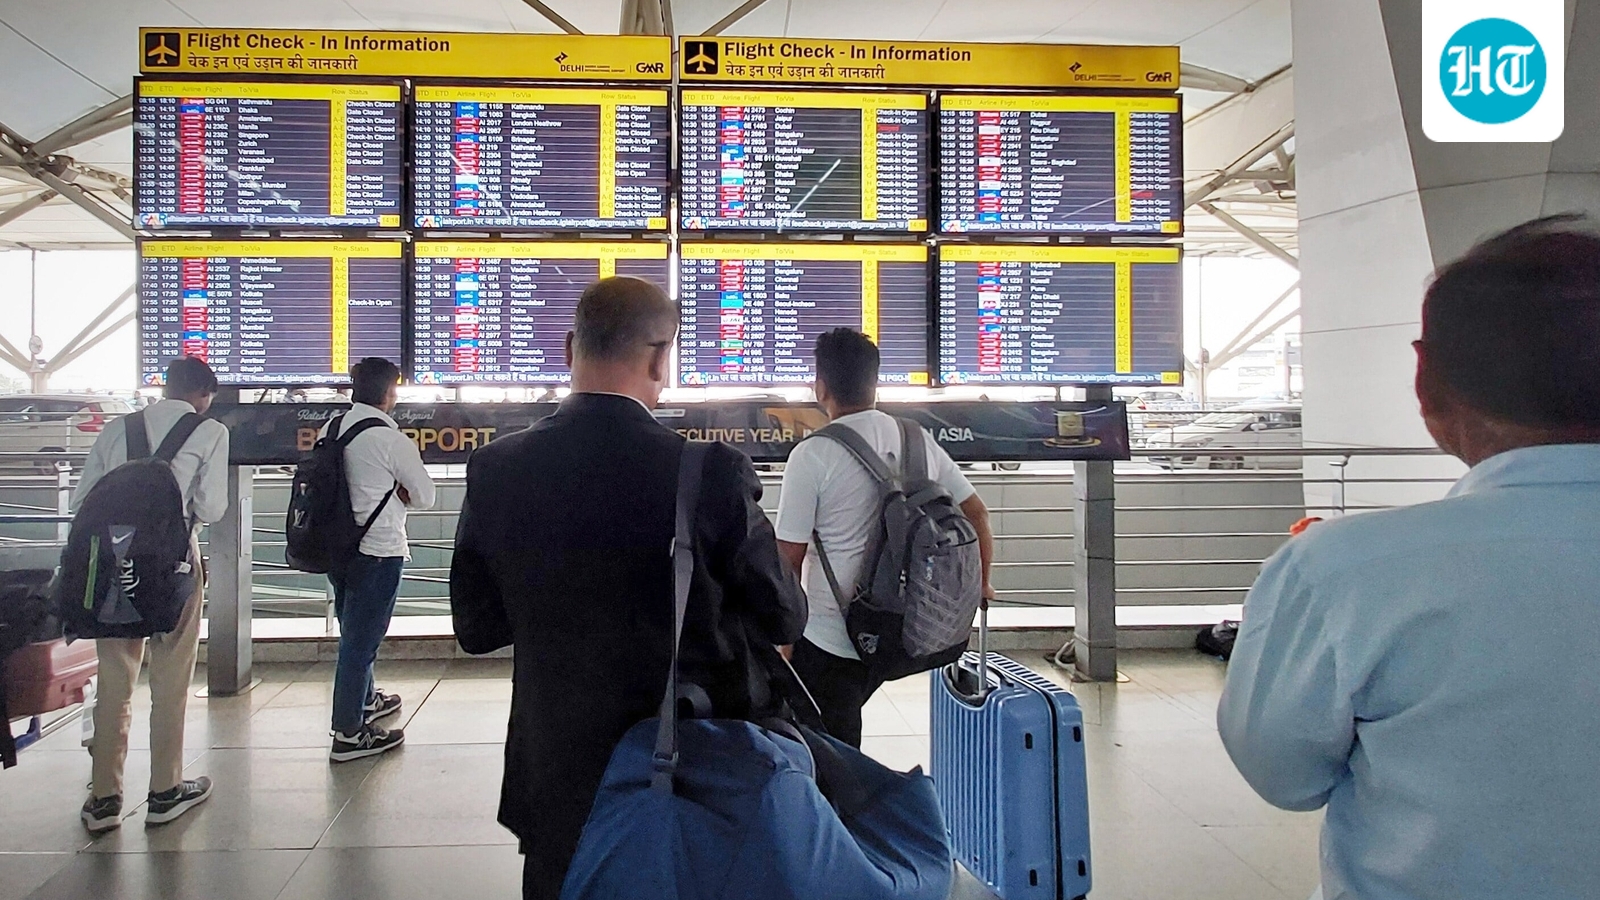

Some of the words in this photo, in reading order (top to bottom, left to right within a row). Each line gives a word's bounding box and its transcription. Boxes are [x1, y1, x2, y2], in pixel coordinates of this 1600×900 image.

[187, 33, 239, 50] Flight
[246, 34, 304, 49] Check
[322, 36, 338, 49] In
[344, 36, 450, 51] Information
[725, 42, 774, 59] Flight
[780, 43, 834, 58] Check
[851, 45, 865, 59] In
[872, 46, 970, 60] Information
[188, 52, 209, 67] चेक
[213, 56, 227, 69] इन
[234, 53, 249, 69] एवं
[254, 57, 283, 71] उड़ान
[288, 54, 303, 69] की
[308, 54, 358, 70] जानकारी
[725, 61, 745, 76] चेक
[750, 65, 763, 77] इन
[768, 62, 783, 77] एवं
[787, 65, 814, 79] उड़ान
[819, 62, 834, 77] की
[838, 63, 885, 79] जानकारी
[298, 409, 327, 419] Rated
[399, 409, 435, 424] Again!
[402, 428, 496, 451] RPORT
[750, 428, 793, 442] YEAR
[938, 428, 974, 441] ASIA
